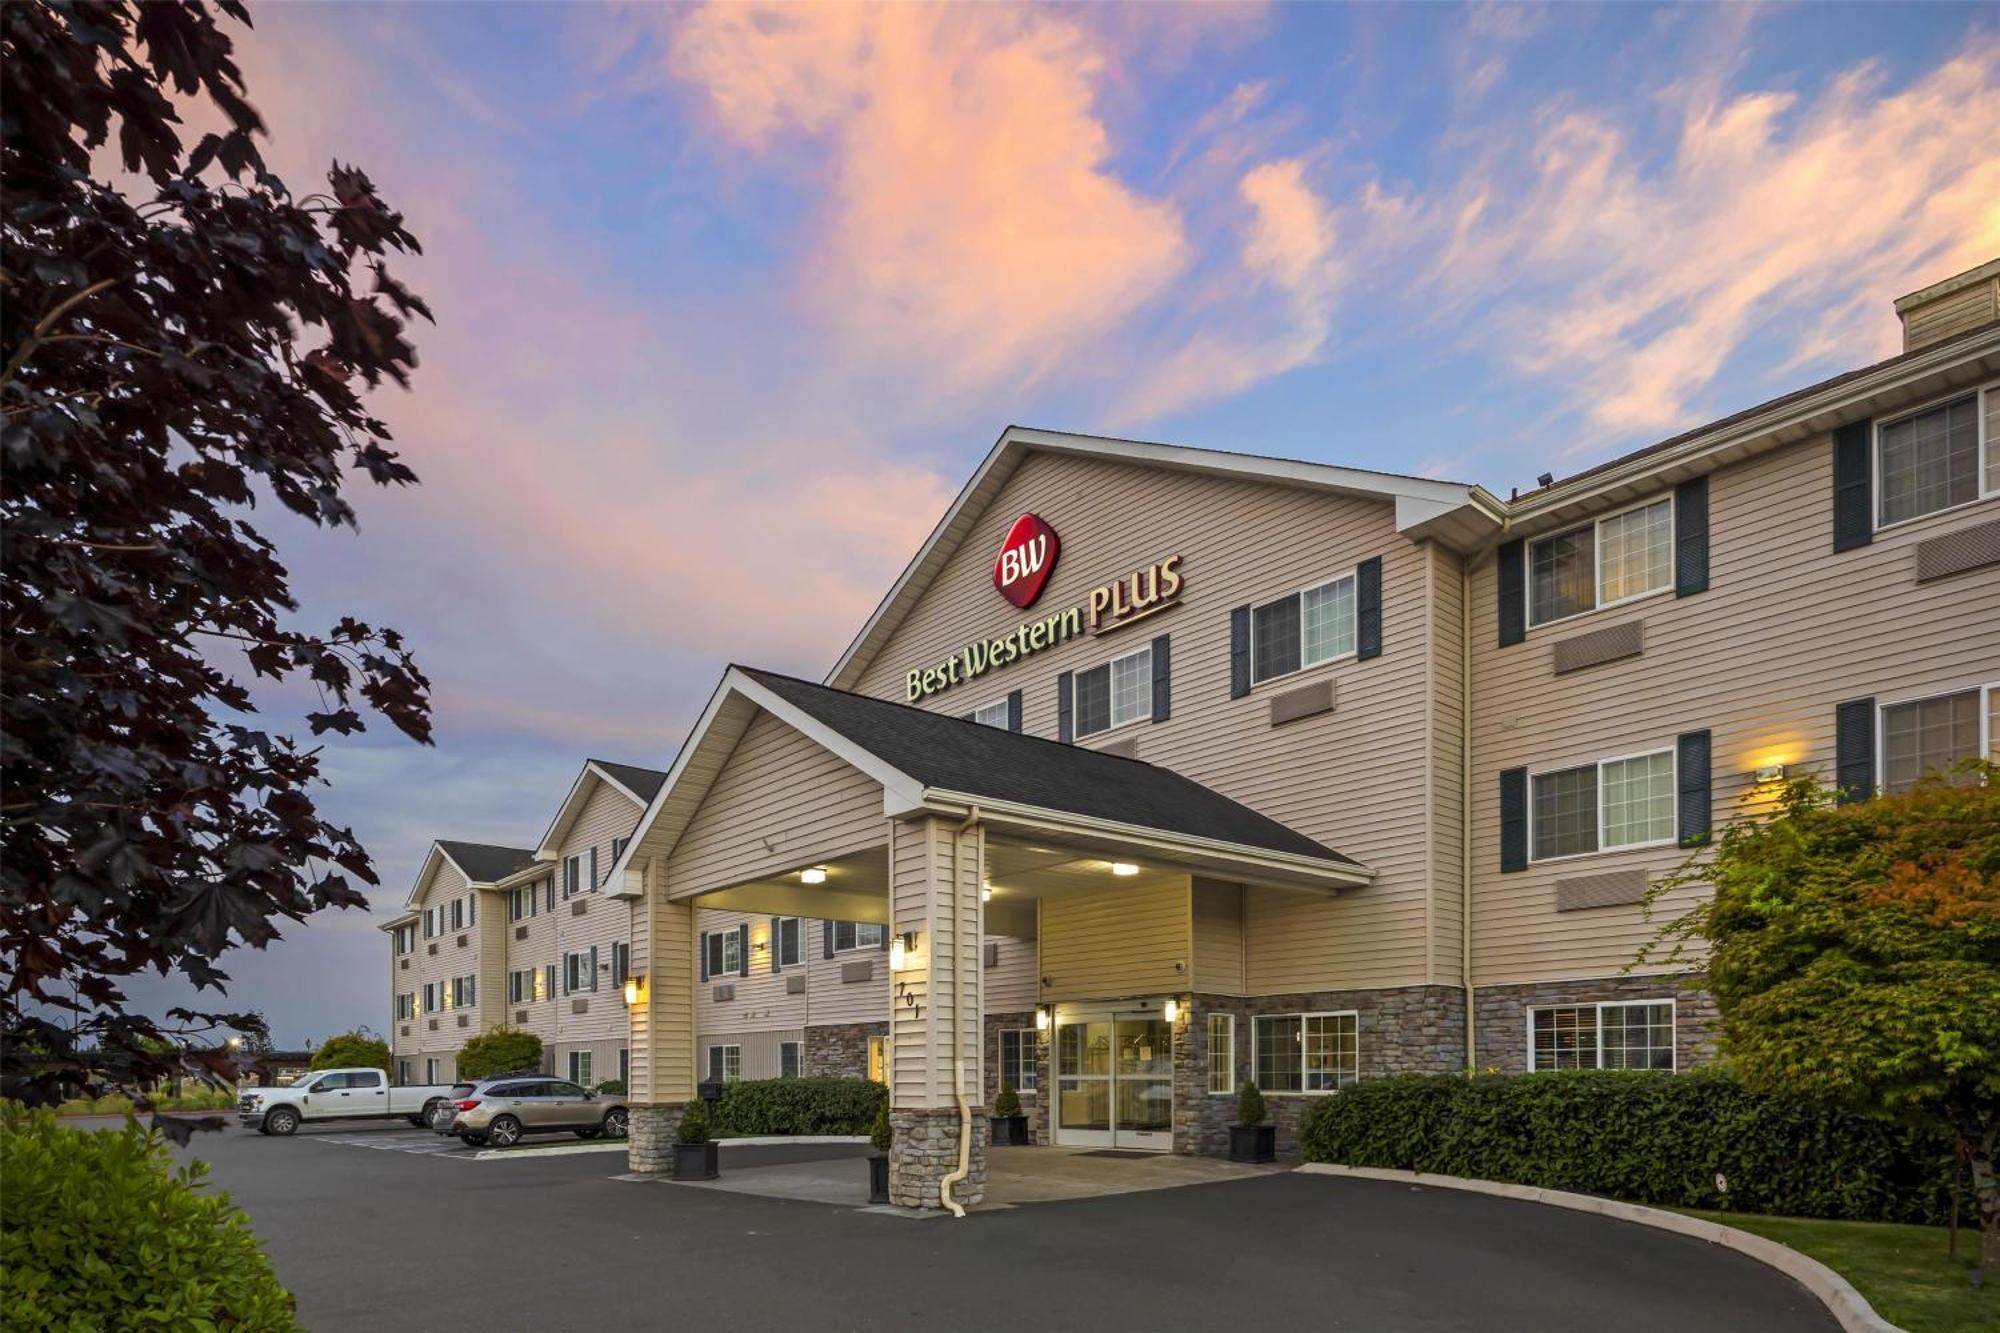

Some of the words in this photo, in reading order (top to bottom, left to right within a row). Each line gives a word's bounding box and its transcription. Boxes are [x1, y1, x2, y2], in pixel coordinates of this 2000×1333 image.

[1001, 533, 1046, 587] BW
[905, 656, 960, 702] Best
[963, 607, 1083, 679] Western
[1089, 554, 1183, 628] PLUS
[897, 981, 919, 1019] 701
